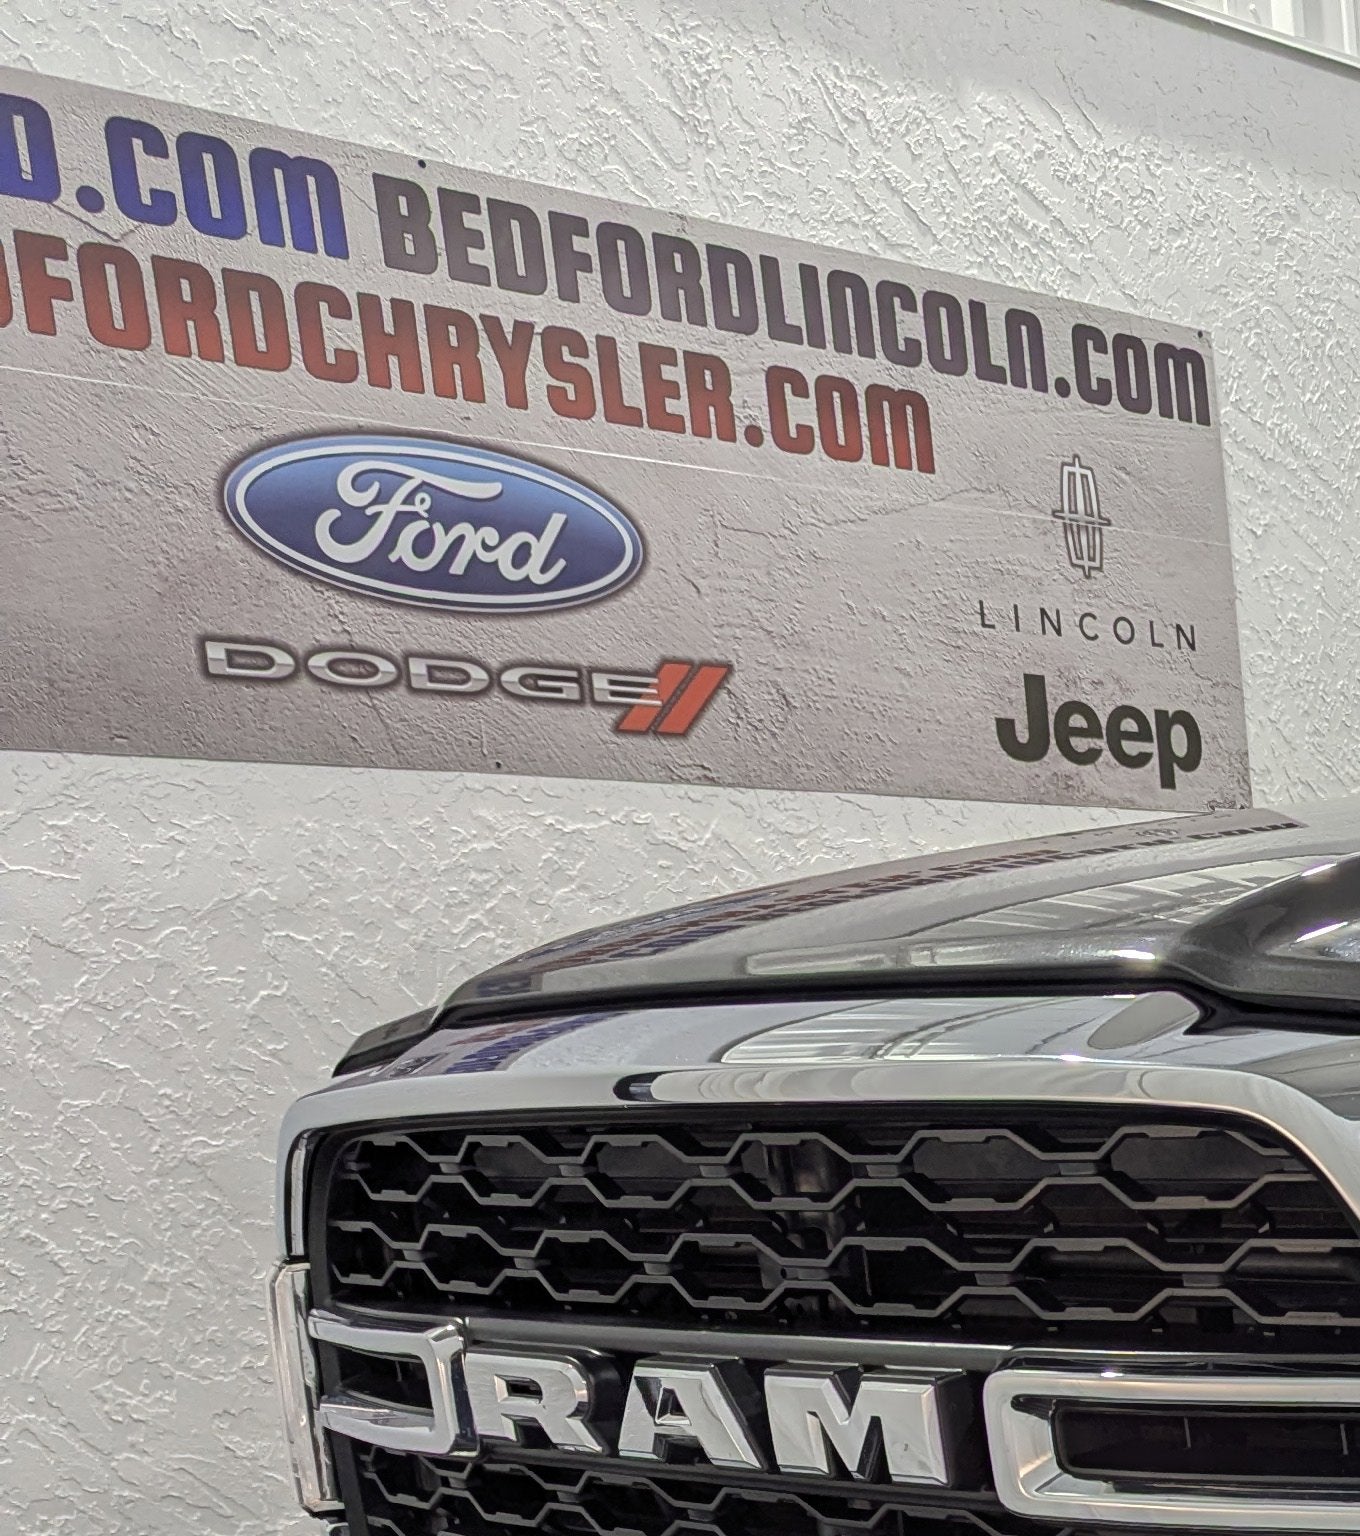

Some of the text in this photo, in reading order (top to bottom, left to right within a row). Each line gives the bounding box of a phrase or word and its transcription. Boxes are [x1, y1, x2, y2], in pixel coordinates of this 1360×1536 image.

[0, 229, 935, 474] FORDCHRYSLER.COM
[373, 172, 1211, 427] BEDFORDLINCOLN.COM
[314, 459, 567, 585] Ford
[204, 640, 663, 706] DODGE
[979, 600, 1197, 653] LINCOLN
[995, 673, 1202, 790] Jeep
[464, 1343, 958, 1488] RAM
